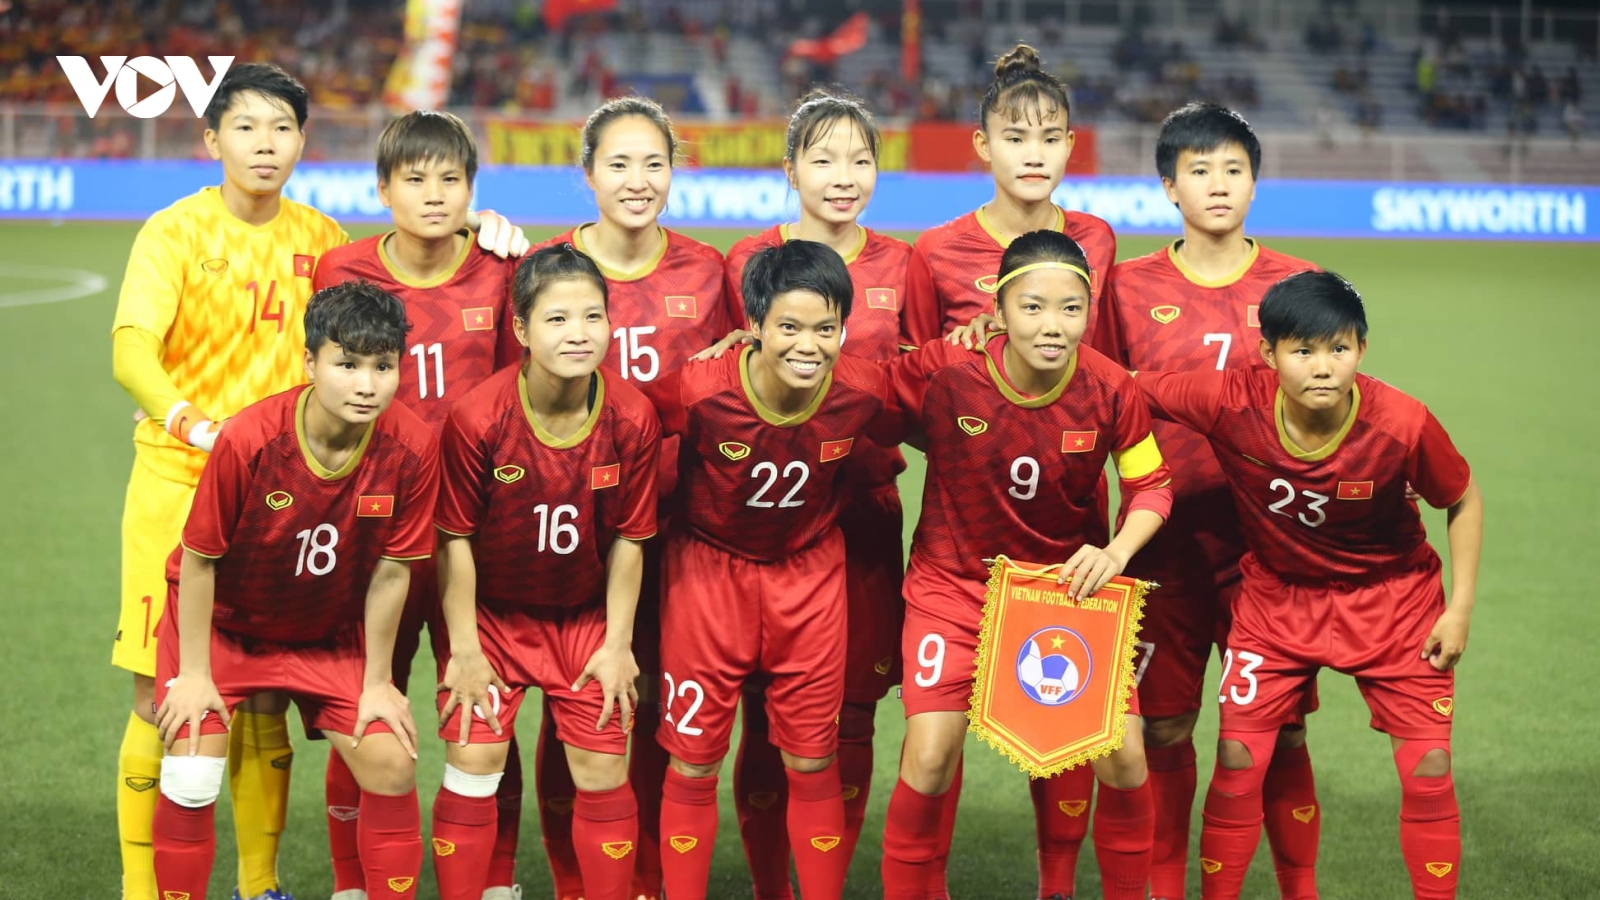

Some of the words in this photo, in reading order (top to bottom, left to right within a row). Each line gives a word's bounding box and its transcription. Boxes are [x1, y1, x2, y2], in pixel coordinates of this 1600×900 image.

[1371, 187, 1587, 234] SKYWORTH
[246, 280, 284, 335] 14
[409, 342, 445, 400] 11
[612, 325, 660, 383] 15
[1202, 332, 1233, 370] 7
[746, 460, 810, 509] 22
[1008, 455, 1040, 501] 9
[1268, 477, 1330, 528] 23
[294, 522, 340, 577] 18
[532, 503, 580, 555] 16
[1011, 586, 1041, 603] VIETNAM
[1041, 590, 1075, 608] FOOTBALL
[914, 633, 946, 688] 9
[1040, 684, 1063, 696] VFF
